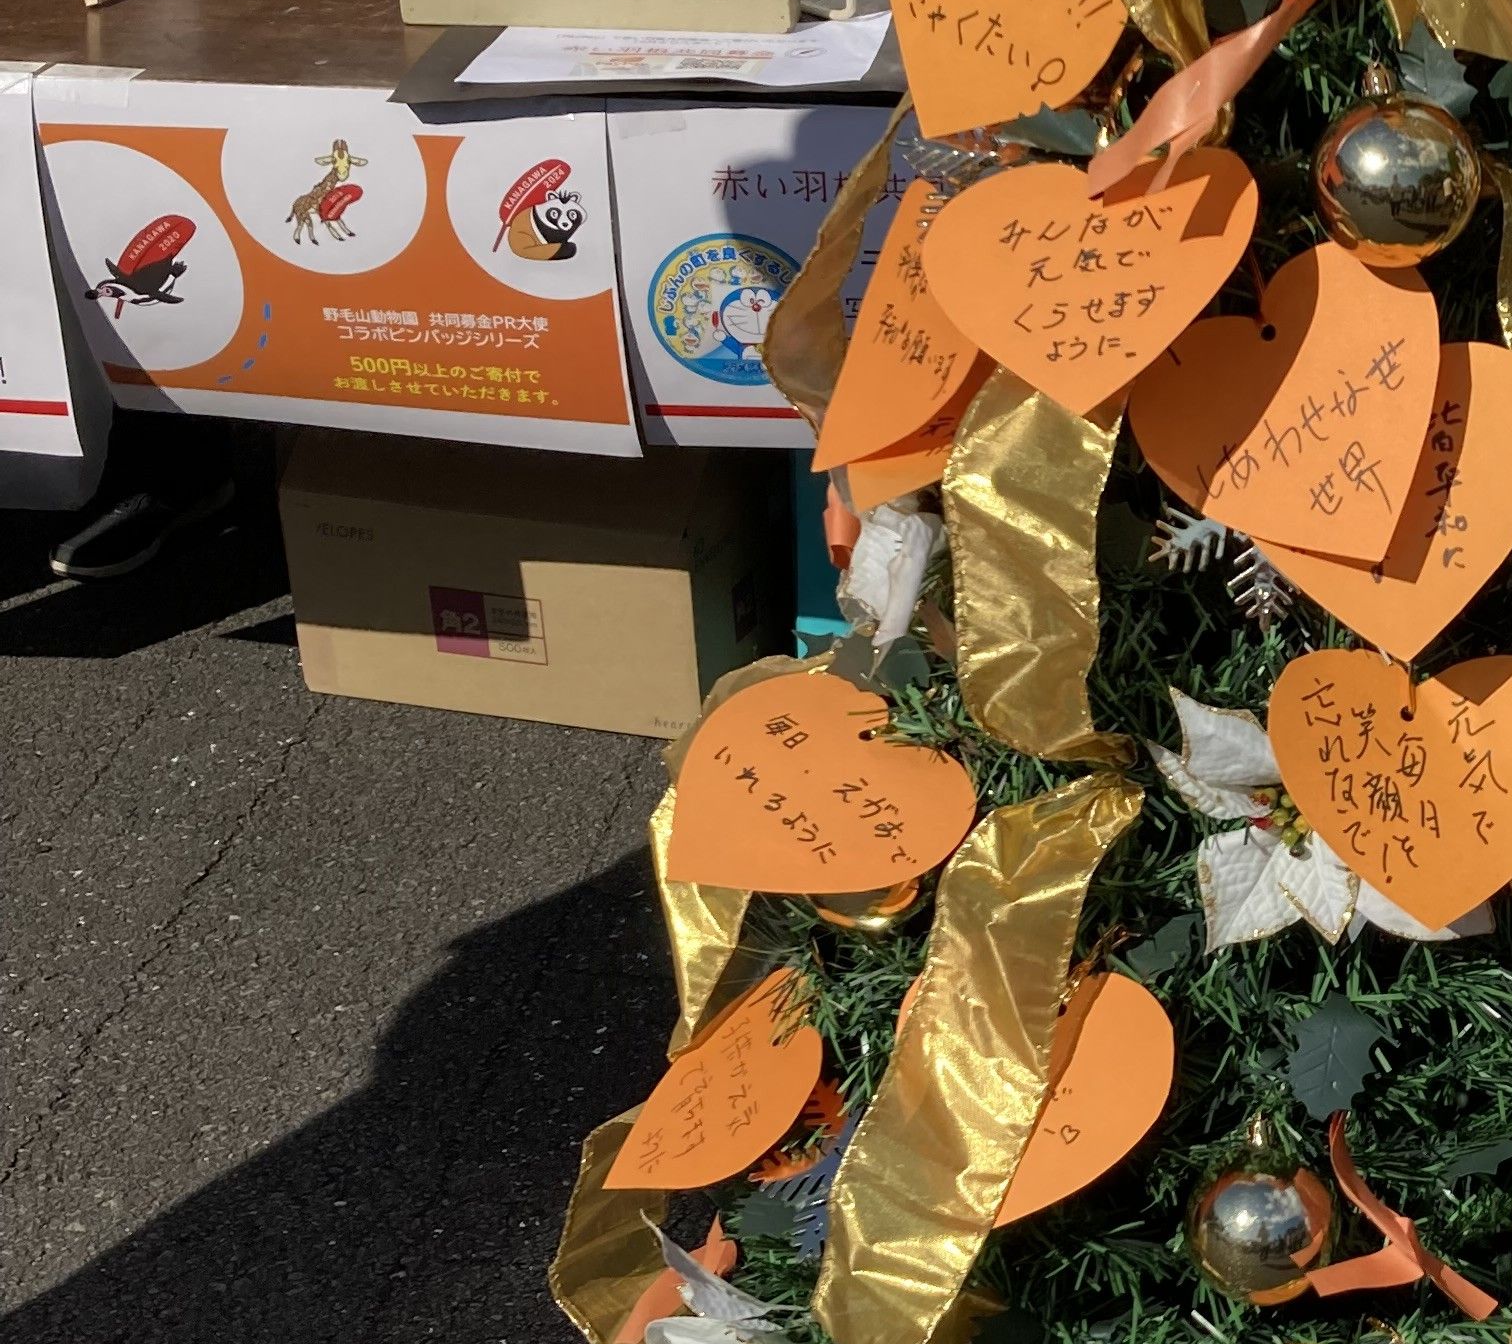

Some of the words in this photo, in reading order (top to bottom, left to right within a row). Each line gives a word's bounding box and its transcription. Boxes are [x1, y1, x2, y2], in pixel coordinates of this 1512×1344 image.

[503, 165, 547, 211] KANAGAWA
[542, 167, 566, 190] 2024
[127, 220, 172, 262] KANAGAWA
[157, 230, 182, 253] 2020
[999, 205, 1173, 252] みんなが
[322, 306, 419, 327] 野毛山動物園
[428, 311, 550, 333] 共同募金PR大使
[338, 325, 541, 350] コラボピンバッジシリーズ
[349, 356, 541, 384] 500円以上のご寄付で
[333, 375, 562, 407] お渡しさせていただきます。
